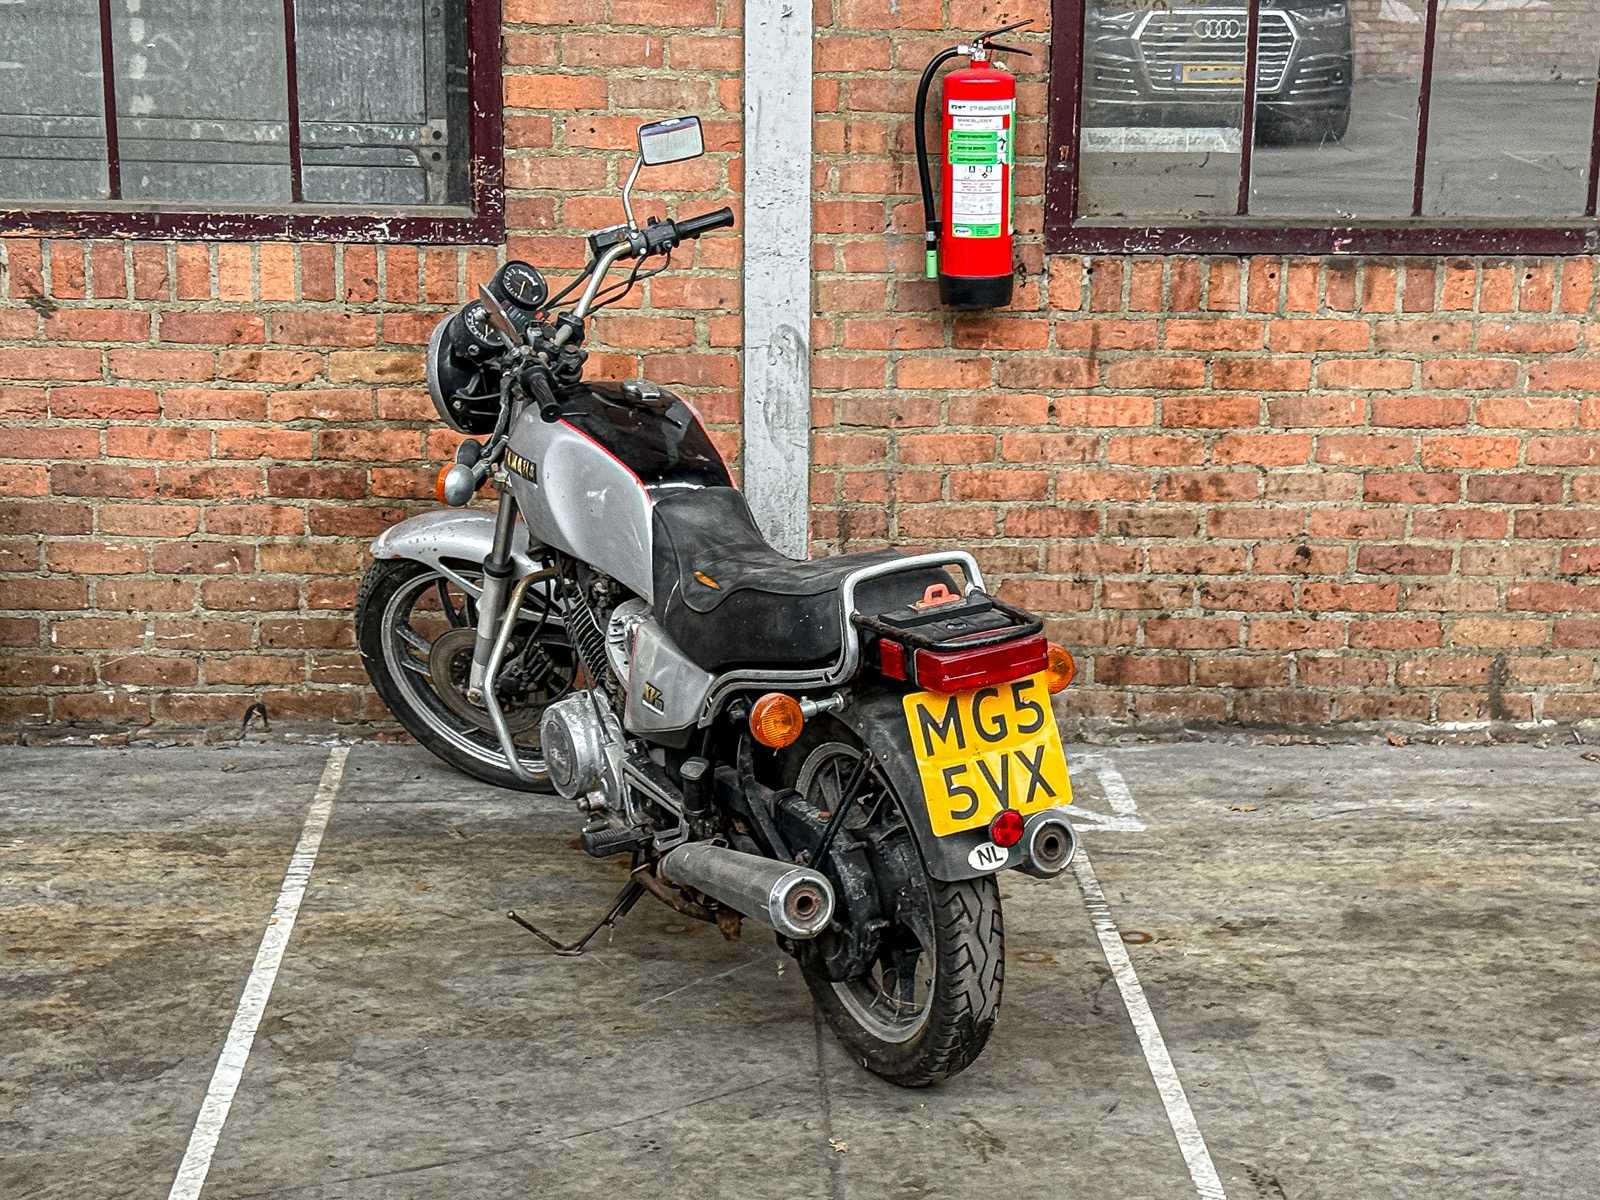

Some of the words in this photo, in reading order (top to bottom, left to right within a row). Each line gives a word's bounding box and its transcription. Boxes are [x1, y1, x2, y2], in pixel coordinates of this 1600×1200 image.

[917, 679, 1045, 756] MG5
[941, 745, 1057, 820] 5VX
[977, 846, 1003, 866] NL
